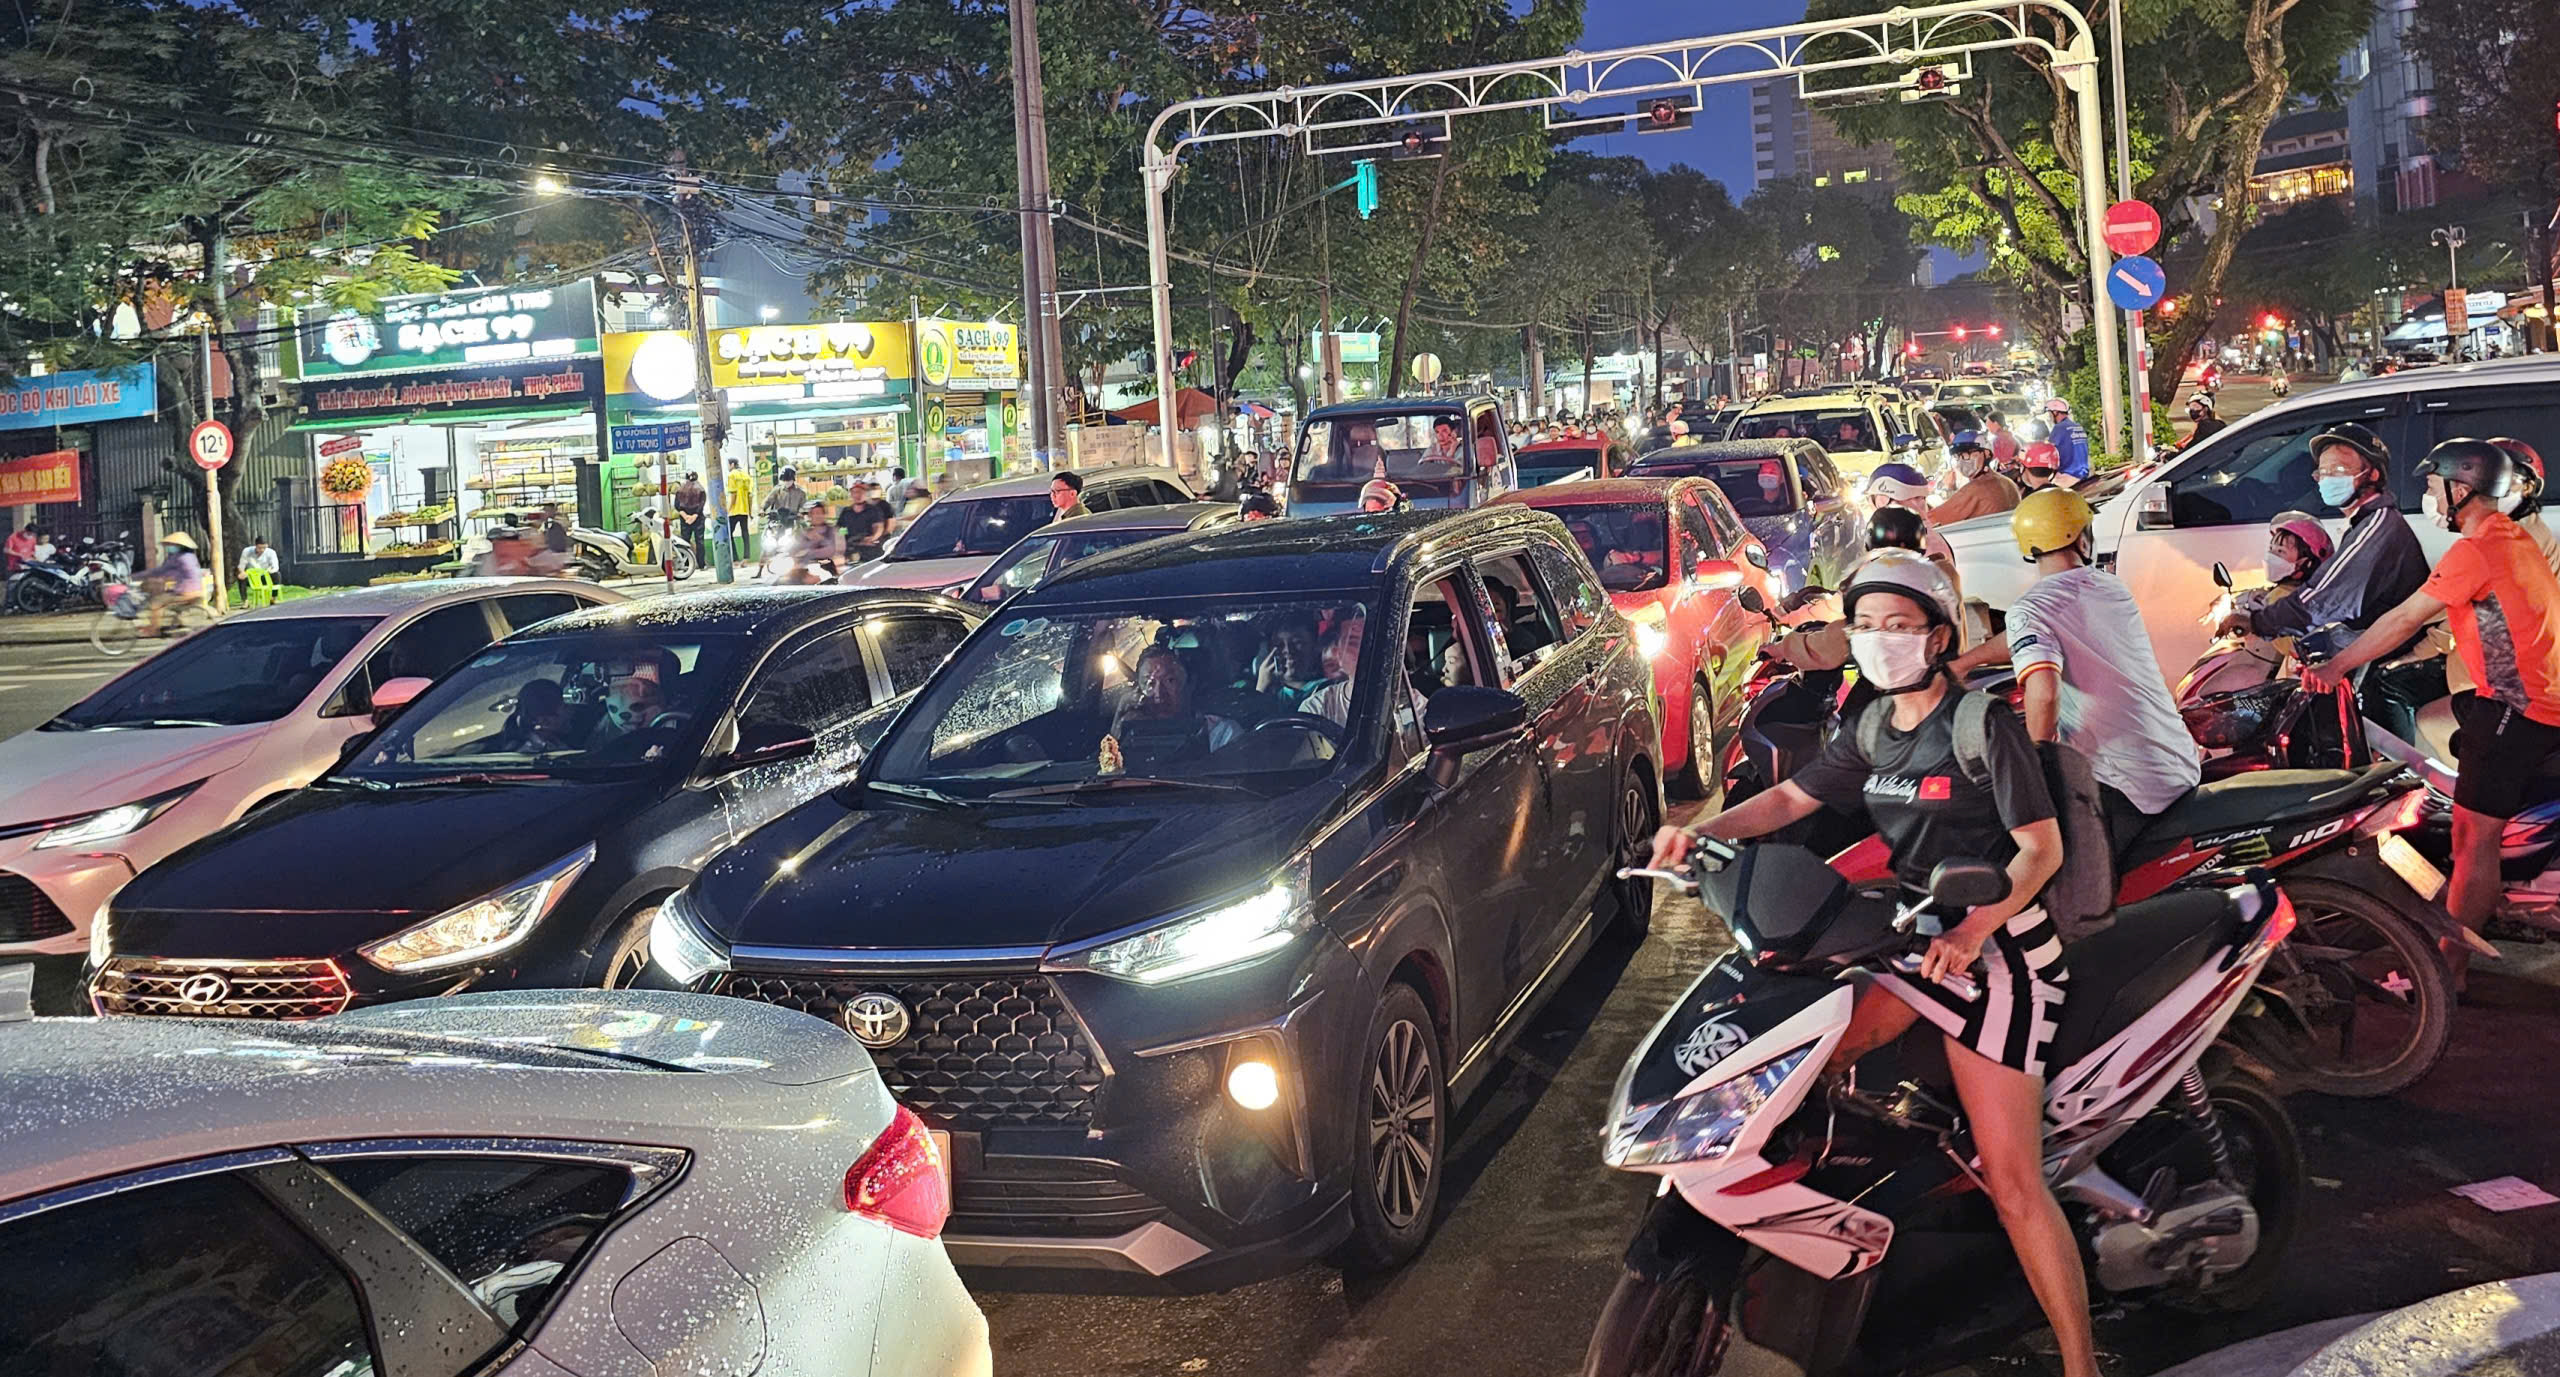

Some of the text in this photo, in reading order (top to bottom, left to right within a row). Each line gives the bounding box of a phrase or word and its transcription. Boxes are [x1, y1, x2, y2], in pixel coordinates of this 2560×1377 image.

[490, 314, 535, 340] 99
[828, 323, 873, 357] 99
[21, 386, 41, 415] ĐỘ
[45, 387, 69, 410] KHI
[73, 380, 97, 407] LÁI
[101, 381, 121, 404] XE
[2196, 826, 2274, 848] BLADE
[2289, 819, 2344, 849] 110
